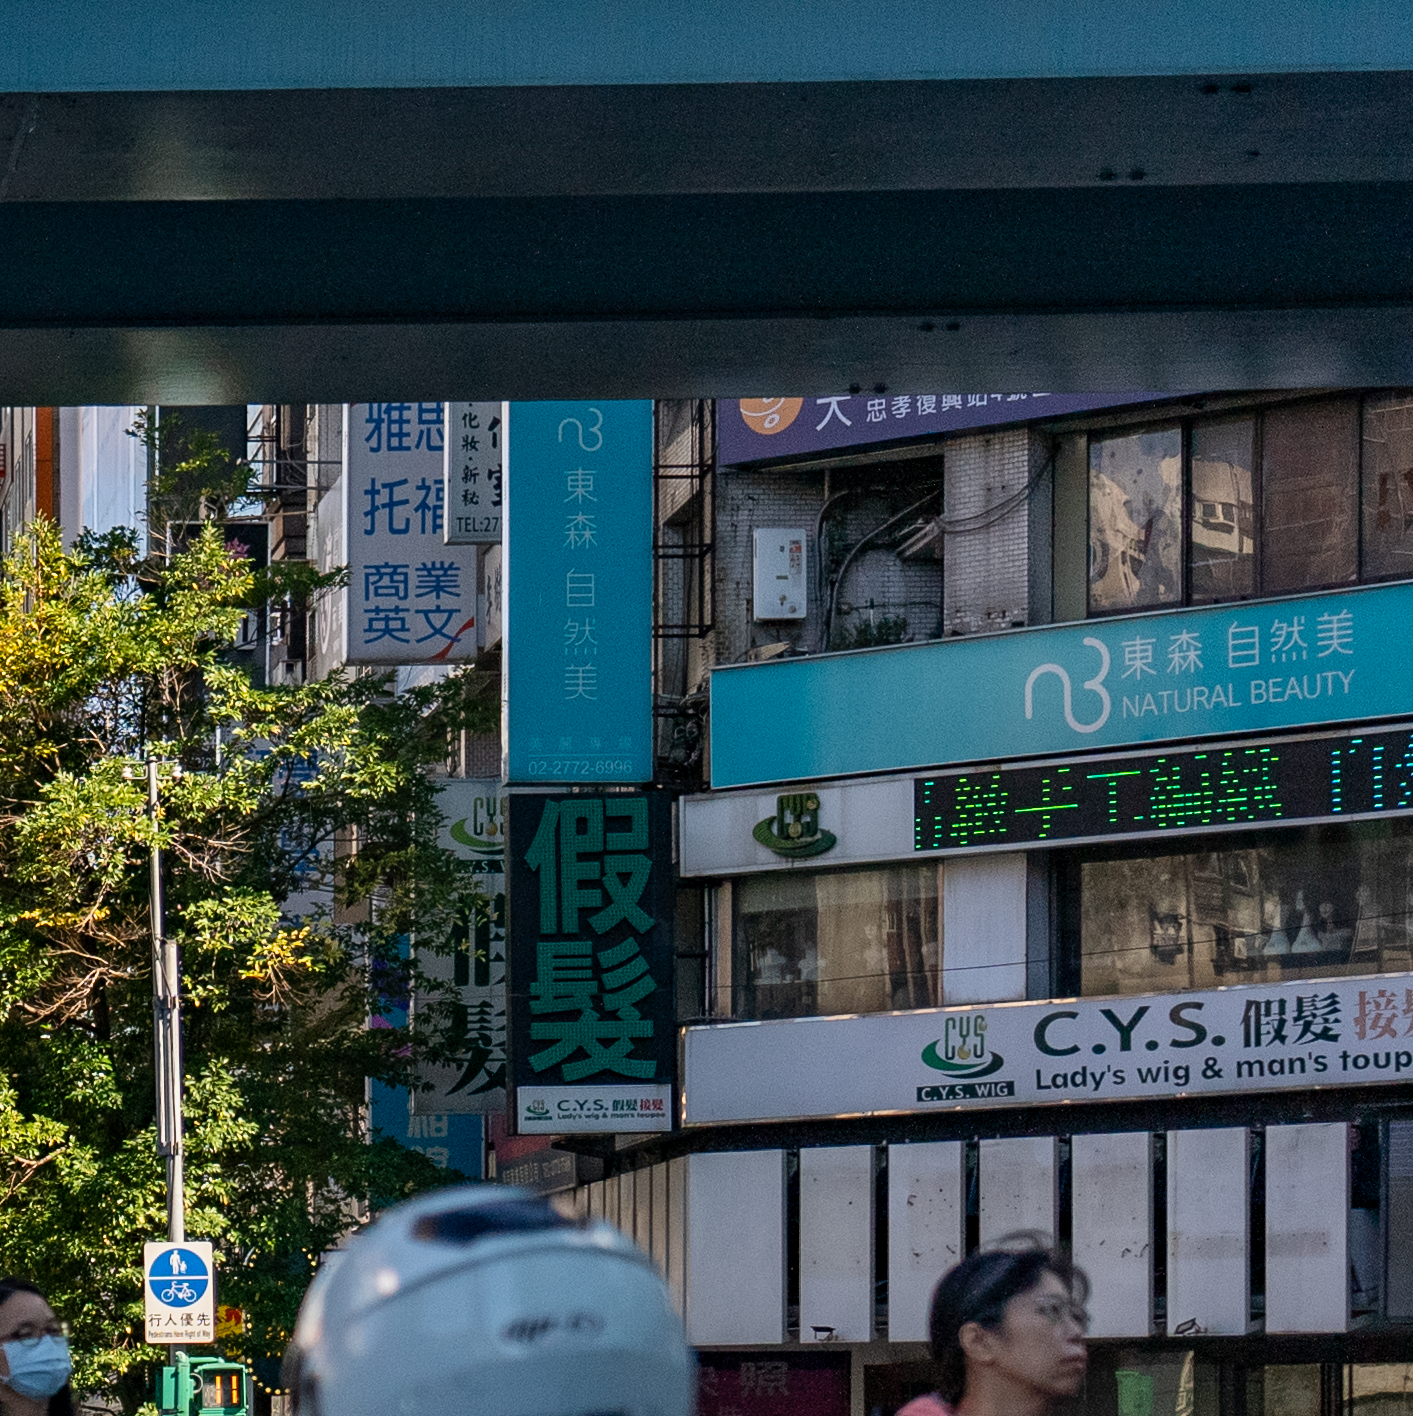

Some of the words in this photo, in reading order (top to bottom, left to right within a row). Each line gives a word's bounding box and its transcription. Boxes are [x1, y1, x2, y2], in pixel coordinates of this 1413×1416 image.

[456, 516, 502, 533] TEL:27
[563, 468, 598, 549] 東森
[363, 561, 461, 600] 商業
[363, 604, 461, 645] 英文
[563, 568, 598, 700] 自然美
[1122, 629, 1204, 680] 東森
[1228, 609, 1354, 668] 自然美
[1123, 684, 1242, 718] NATURAL
[1251, 669, 1356, 704] BEAUTY
[524, 797, 657, 1083] 假髮
[1033, 1001, 1225, 1056] C.Y.S.
[1241, 991, 1342, 1048] 假髮
[1353, 989, 1413, 1039] 接
[1036, 1063, 1126, 1090] Lady's
[1138, 1056, 1191, 1086] wig
[1202, 1055, 1224, 1080] &
[1236, 1050, 1328, 1079] man's
[557, 1099, 609, 1112] C.Y.S.
[921, 1086, 970, 1101] C.Y.S.
[975, 1082, 1009, 1097] WIG
[148, 1313, 211, 1328] 行人優先
[215, 1375, 238, 1404] 11
